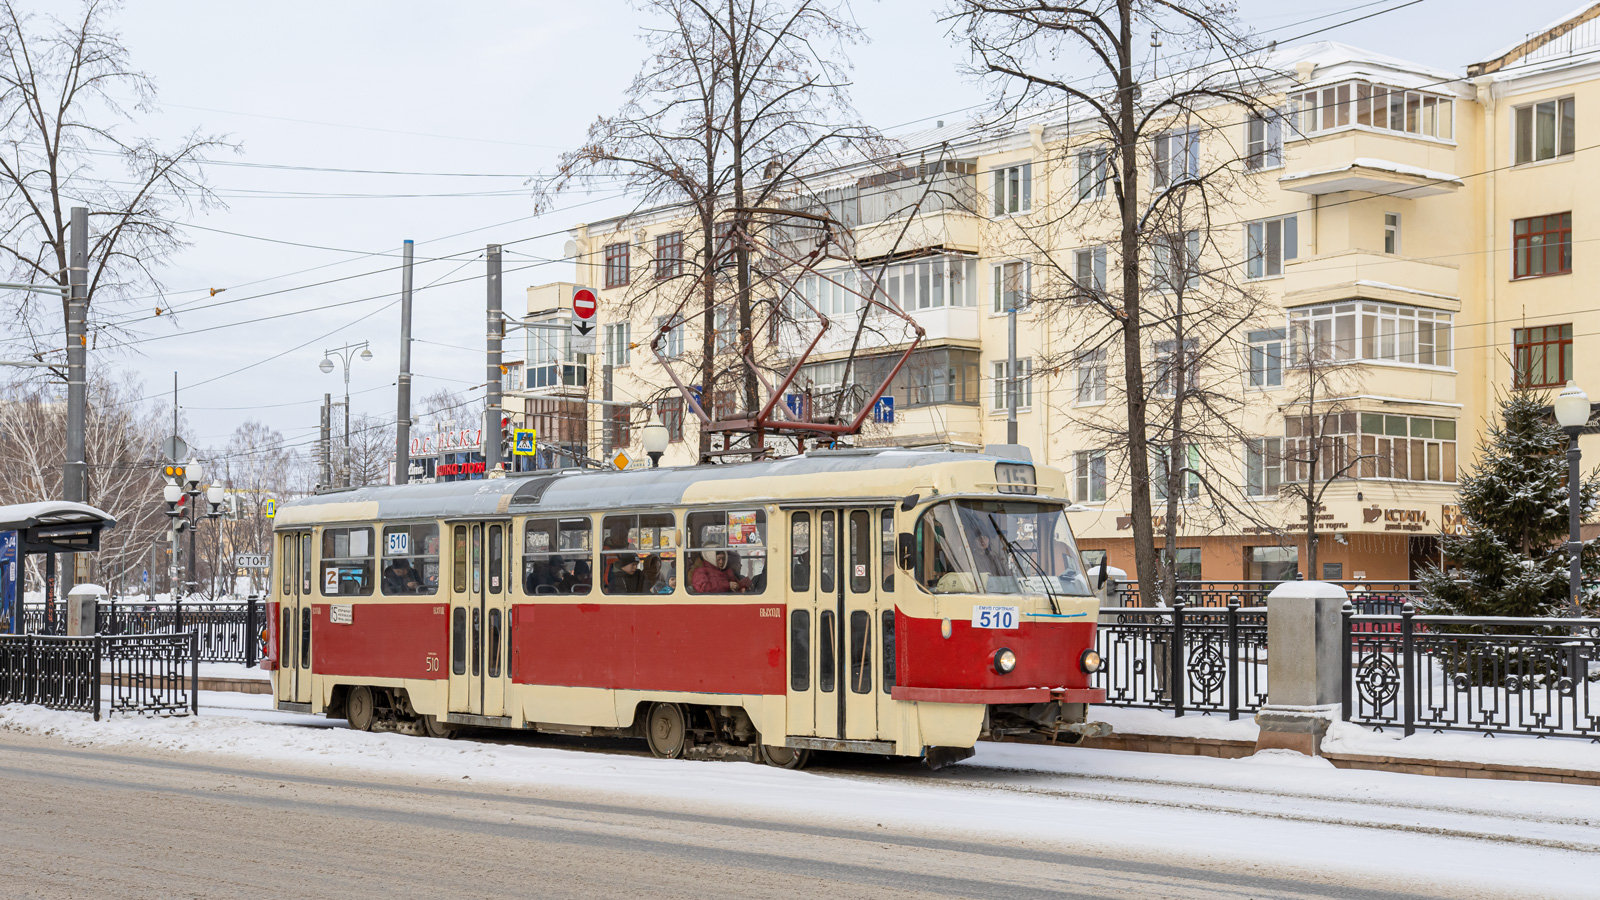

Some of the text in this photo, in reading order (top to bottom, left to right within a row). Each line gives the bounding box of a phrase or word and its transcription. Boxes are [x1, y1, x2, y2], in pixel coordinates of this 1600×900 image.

[1003, 468, 1028, 493] 15
[390, 534, 407, 550] 510
[238, 556, 267, 566] СТОП
[331, 606, 338, 622] 15
[759, 607, 781, 618] ВЫХОД
[980, 611, 1012, 628] 510
[426, 657, 439, 671] 510
